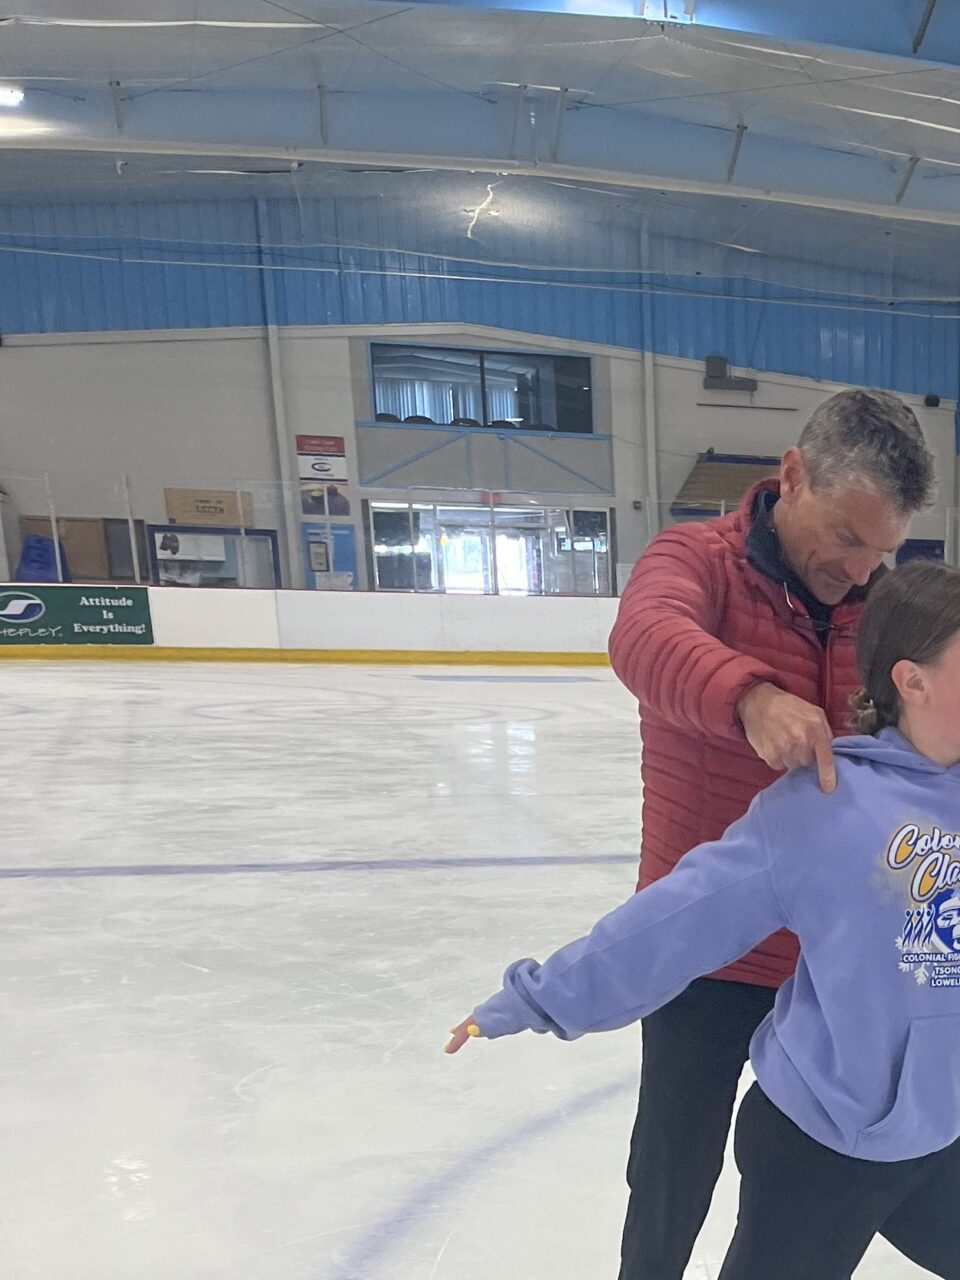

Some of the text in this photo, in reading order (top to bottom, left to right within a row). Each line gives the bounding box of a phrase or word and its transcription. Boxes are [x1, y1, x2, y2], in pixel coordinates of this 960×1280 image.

[80, 596, 133, 606] Attitude
[102, 610, 114, 619] Is
[73, 623, 146, 634] Everything!
[903, 953, 946, 963] COLONIAL
